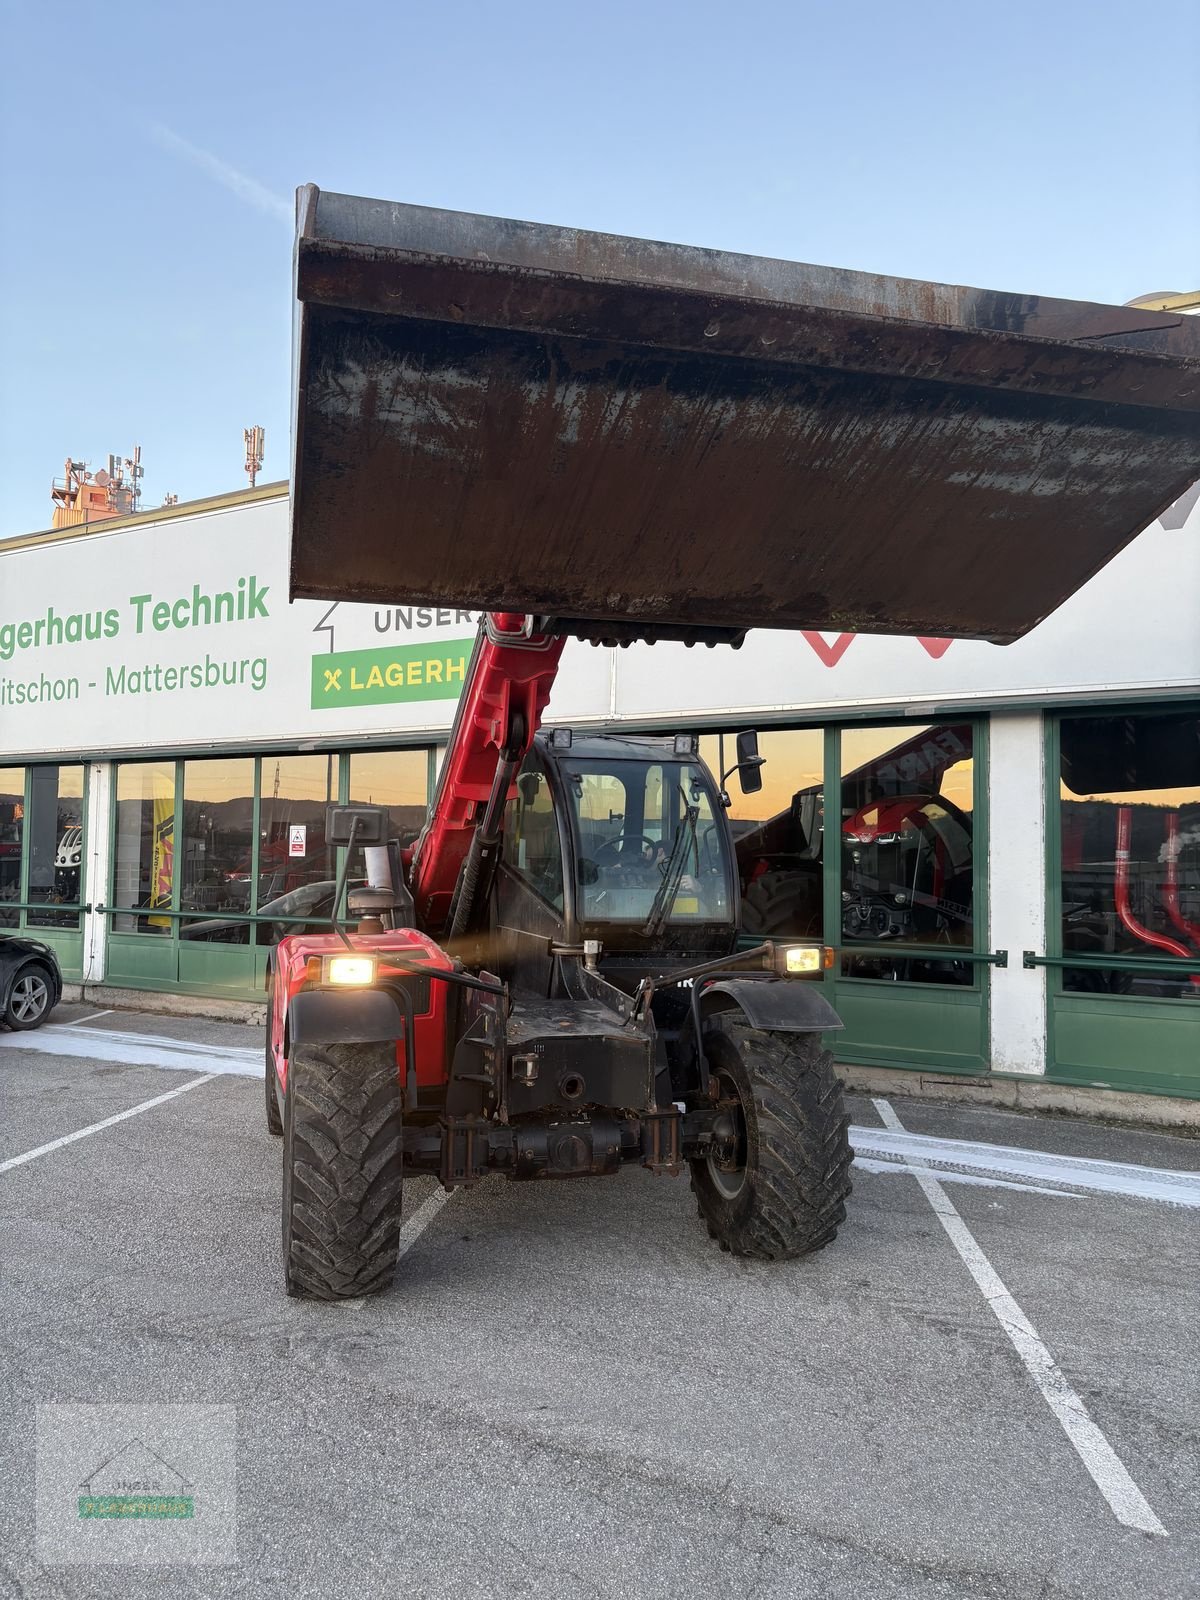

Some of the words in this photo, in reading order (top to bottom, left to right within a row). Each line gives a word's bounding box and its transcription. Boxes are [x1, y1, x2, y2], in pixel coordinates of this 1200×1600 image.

[0, 607, 119, 660] gerhaus
[130, 576, 270, 633] Technik
[375, 606, 472, 633] UNSER
[1, 673, 79, 705] itschon
[106, 654, 267, 695] Mattersburg
[350, 657, 465, 690] LAGERH
